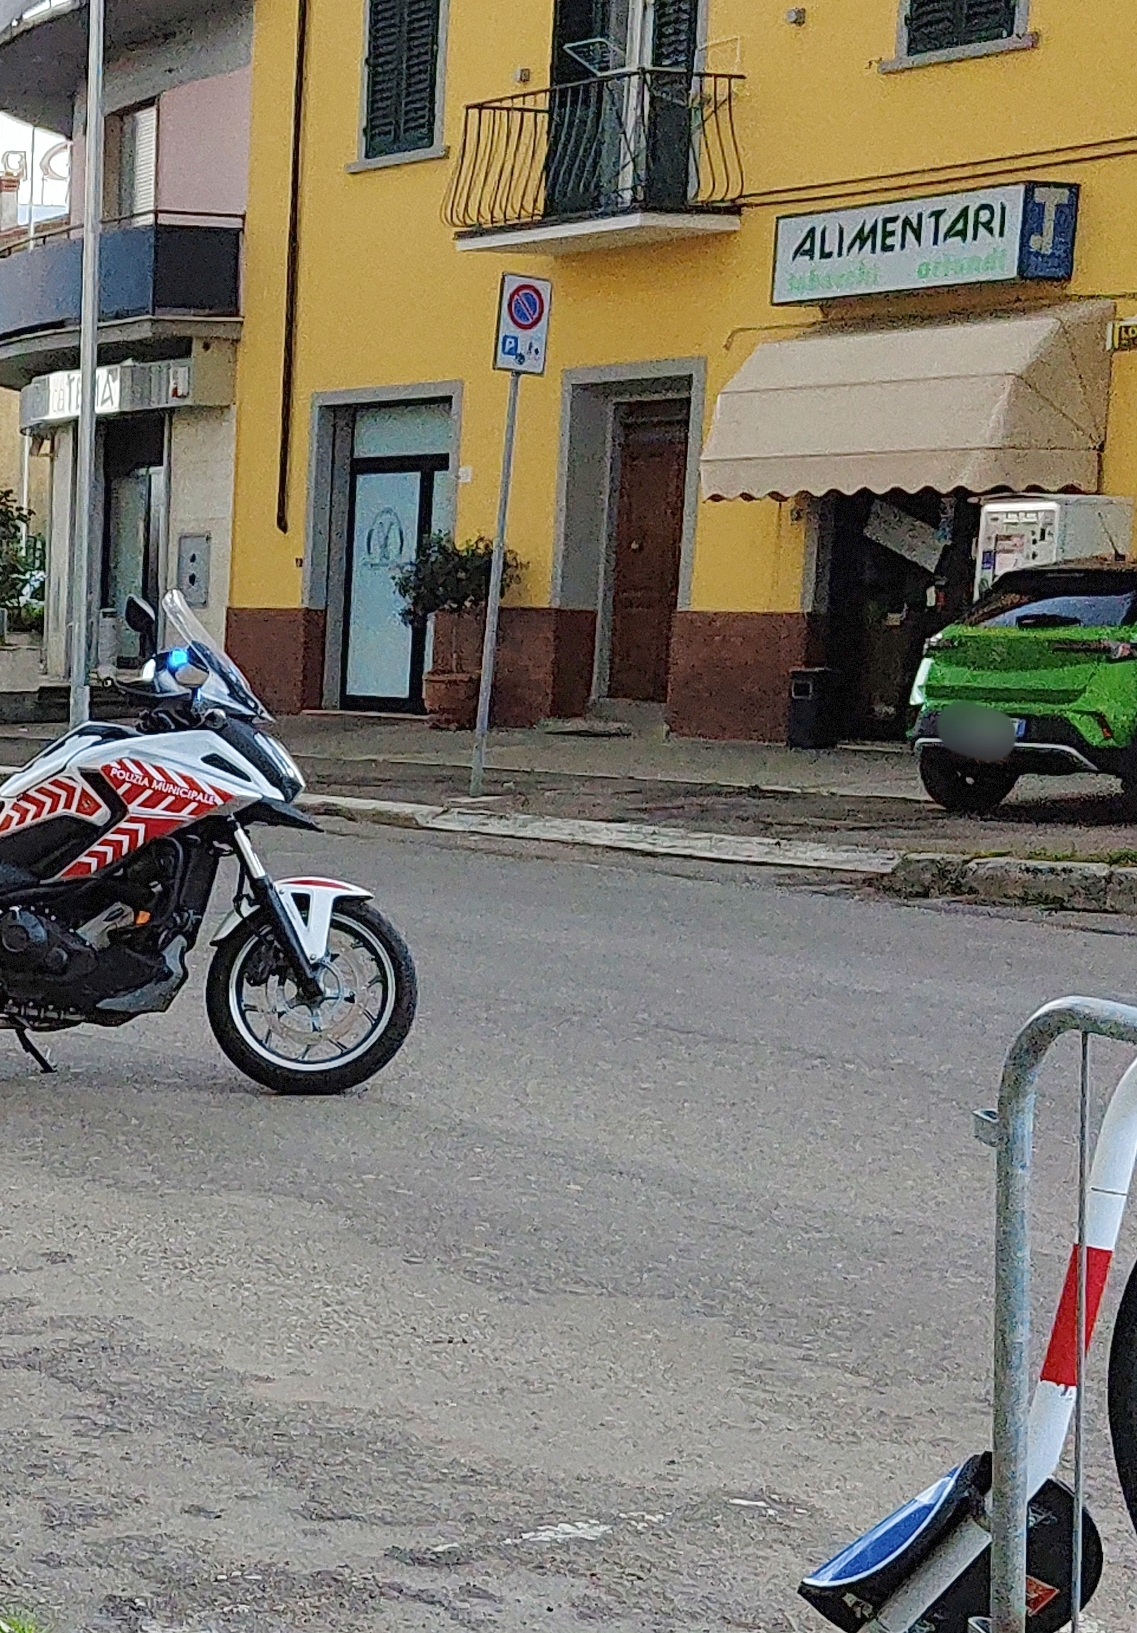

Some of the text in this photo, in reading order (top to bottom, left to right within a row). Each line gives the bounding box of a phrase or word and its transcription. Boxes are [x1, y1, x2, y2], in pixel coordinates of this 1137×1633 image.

[791, 201, 1007, 262] ALIMENTARI
[110, 767, 216, 805] POLIZIA MUNICIPALE
